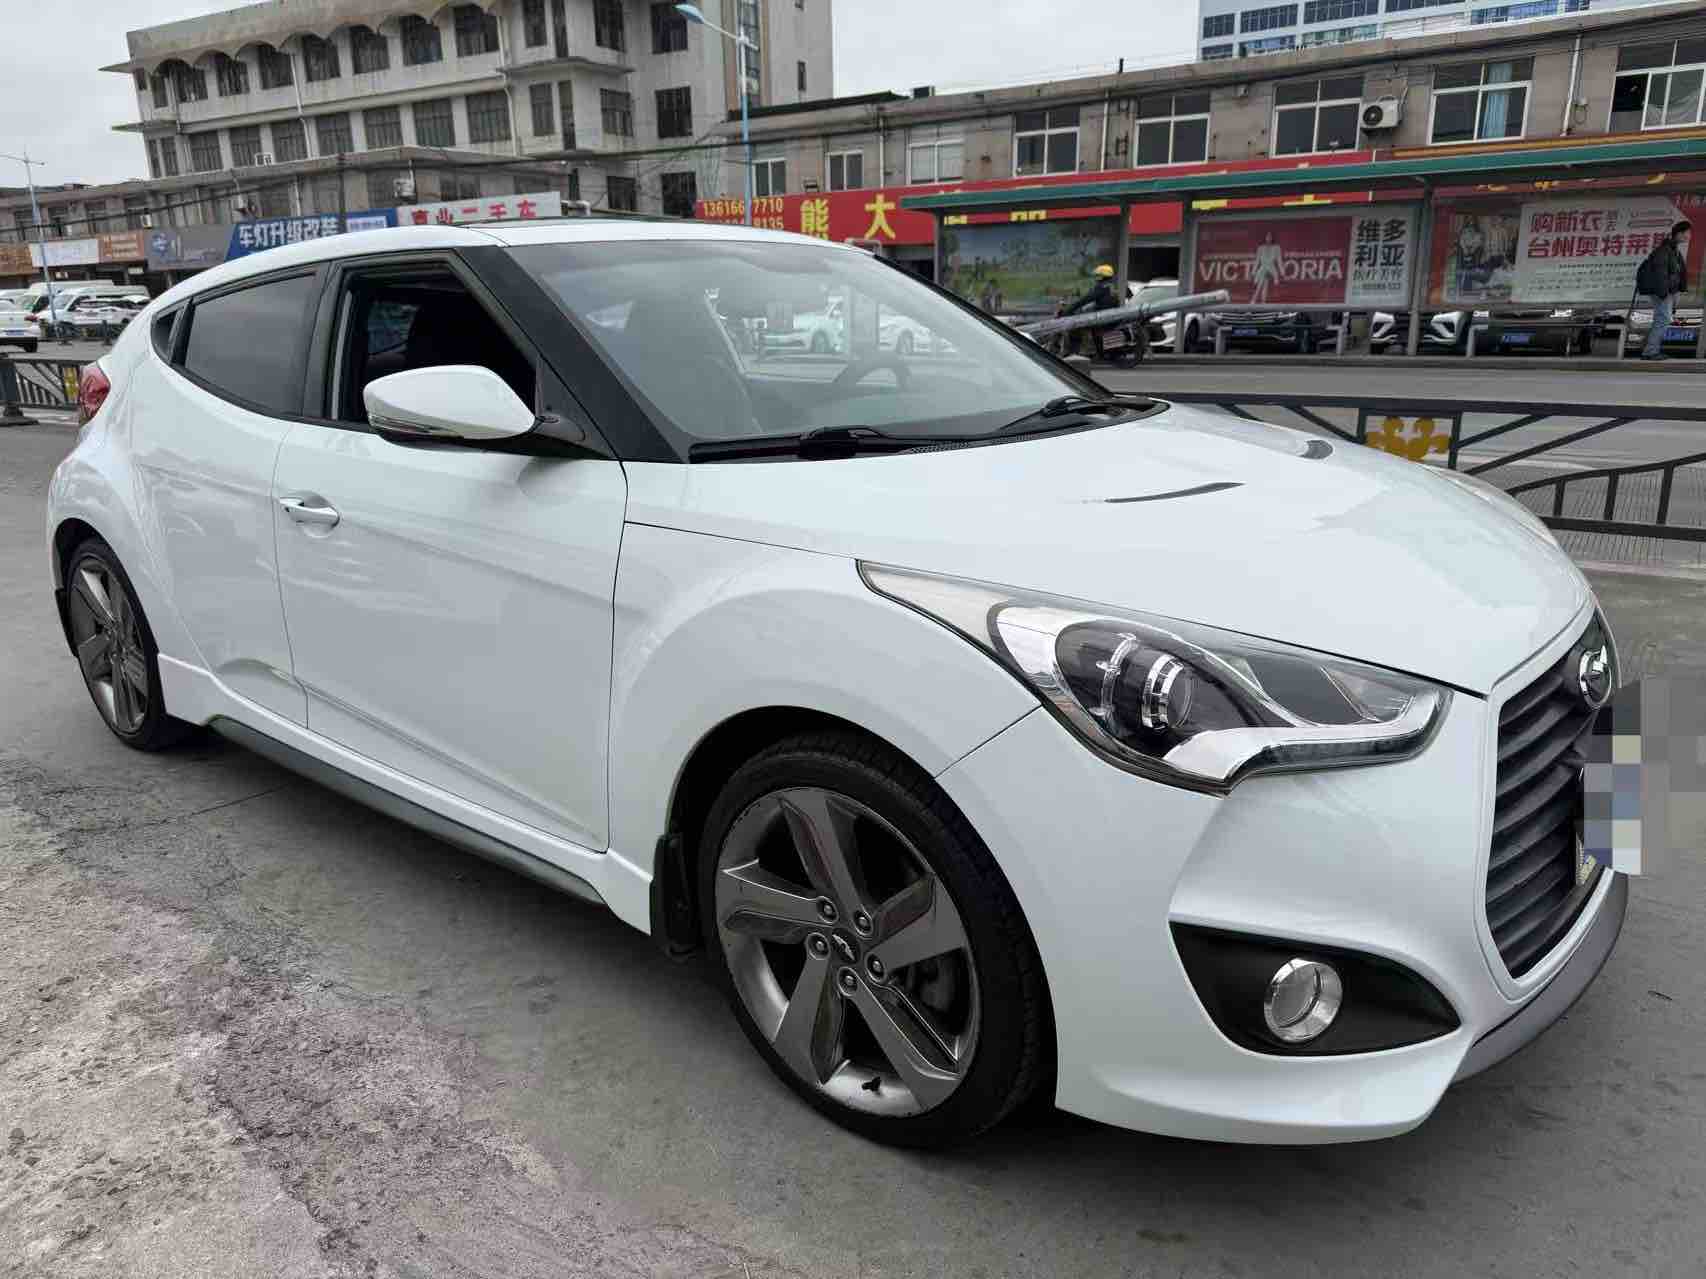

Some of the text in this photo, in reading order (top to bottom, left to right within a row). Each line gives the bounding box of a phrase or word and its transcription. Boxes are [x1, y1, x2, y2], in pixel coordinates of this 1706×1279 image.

[703, 198, 783, 217] 1361667710
[239, 217, 338, 248] 车灯升级改装
[1357, 219, 1405, 243] 维多
[1354, 244, 1405, 267] 利亚
[1200, 257, 1343, 282] VICTORIA
